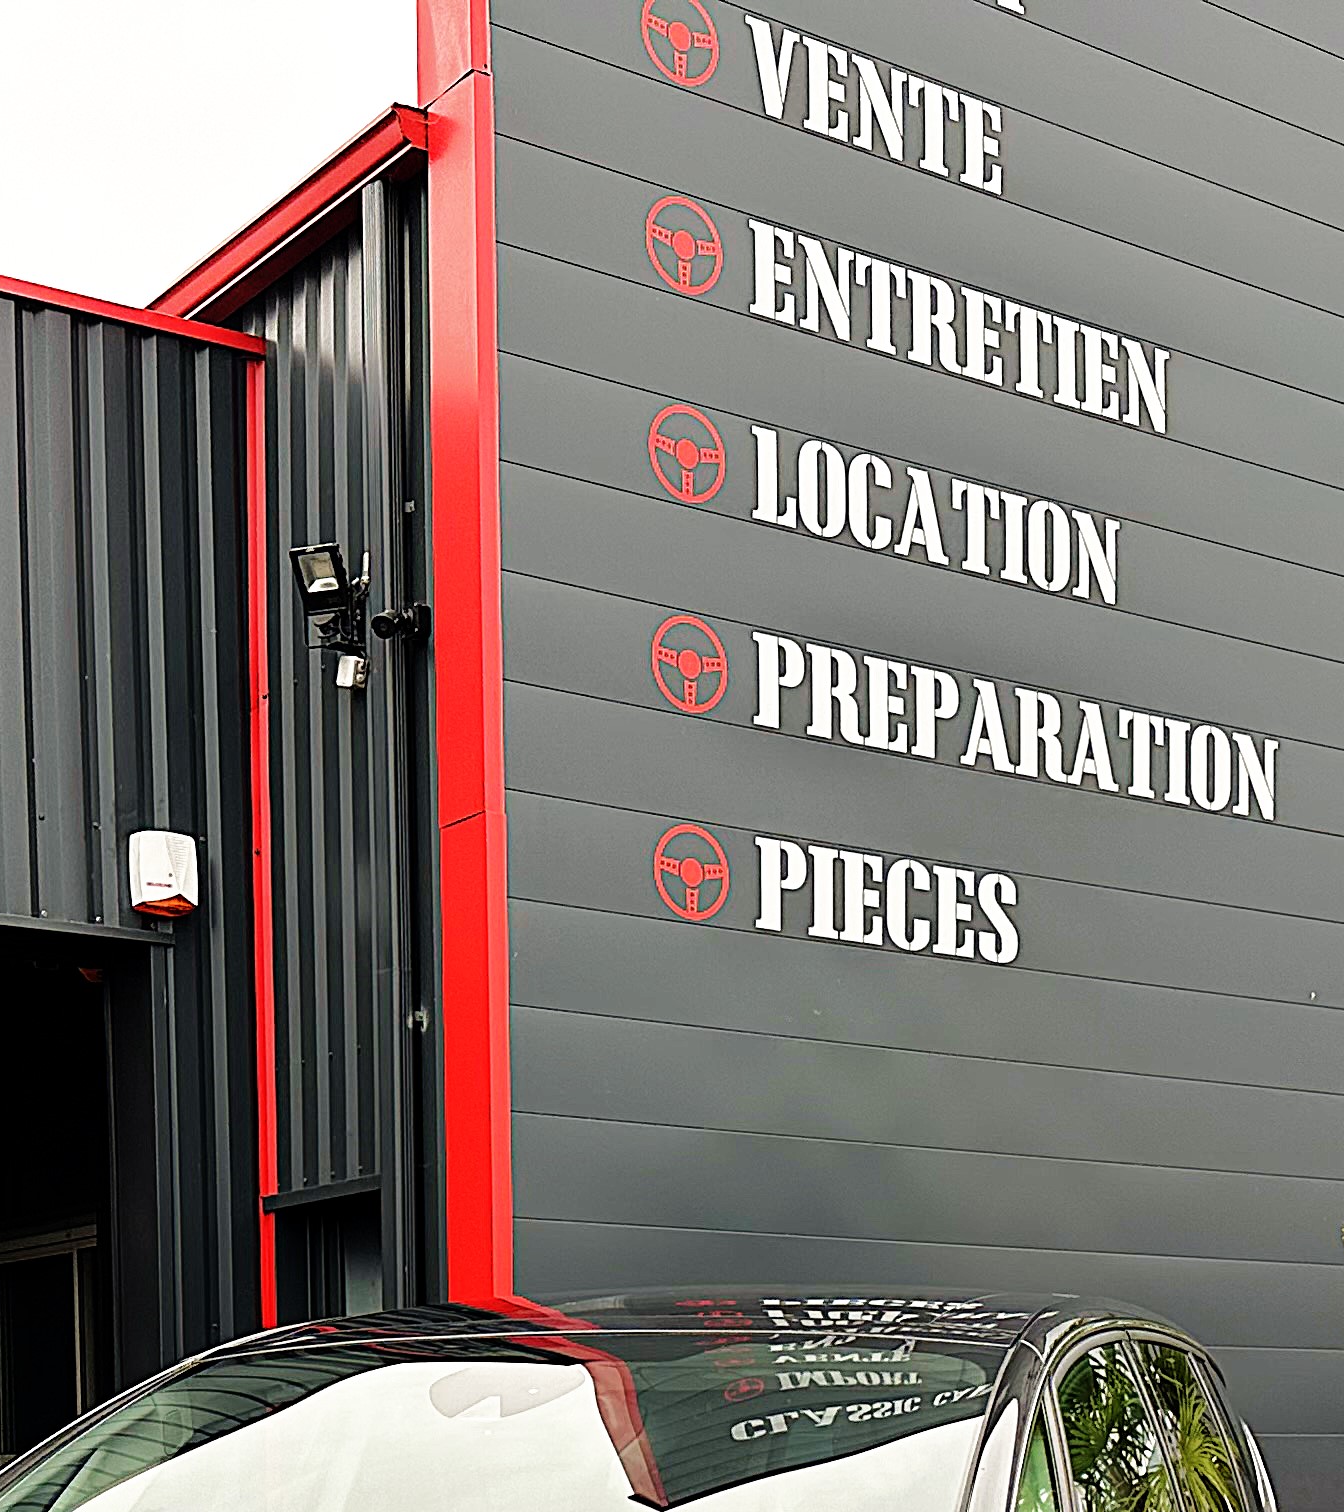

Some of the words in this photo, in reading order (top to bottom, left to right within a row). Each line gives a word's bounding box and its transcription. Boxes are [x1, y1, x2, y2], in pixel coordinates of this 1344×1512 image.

[744, 14, 1003, 195] VENTE
[748, 218, 1171, 435] ENTRETIEN
[750, 424, 1120, 605] LOCATION
[752, 631, 1279, 821] PREPARATION
[755, 836, 1020, 964] PIECES
